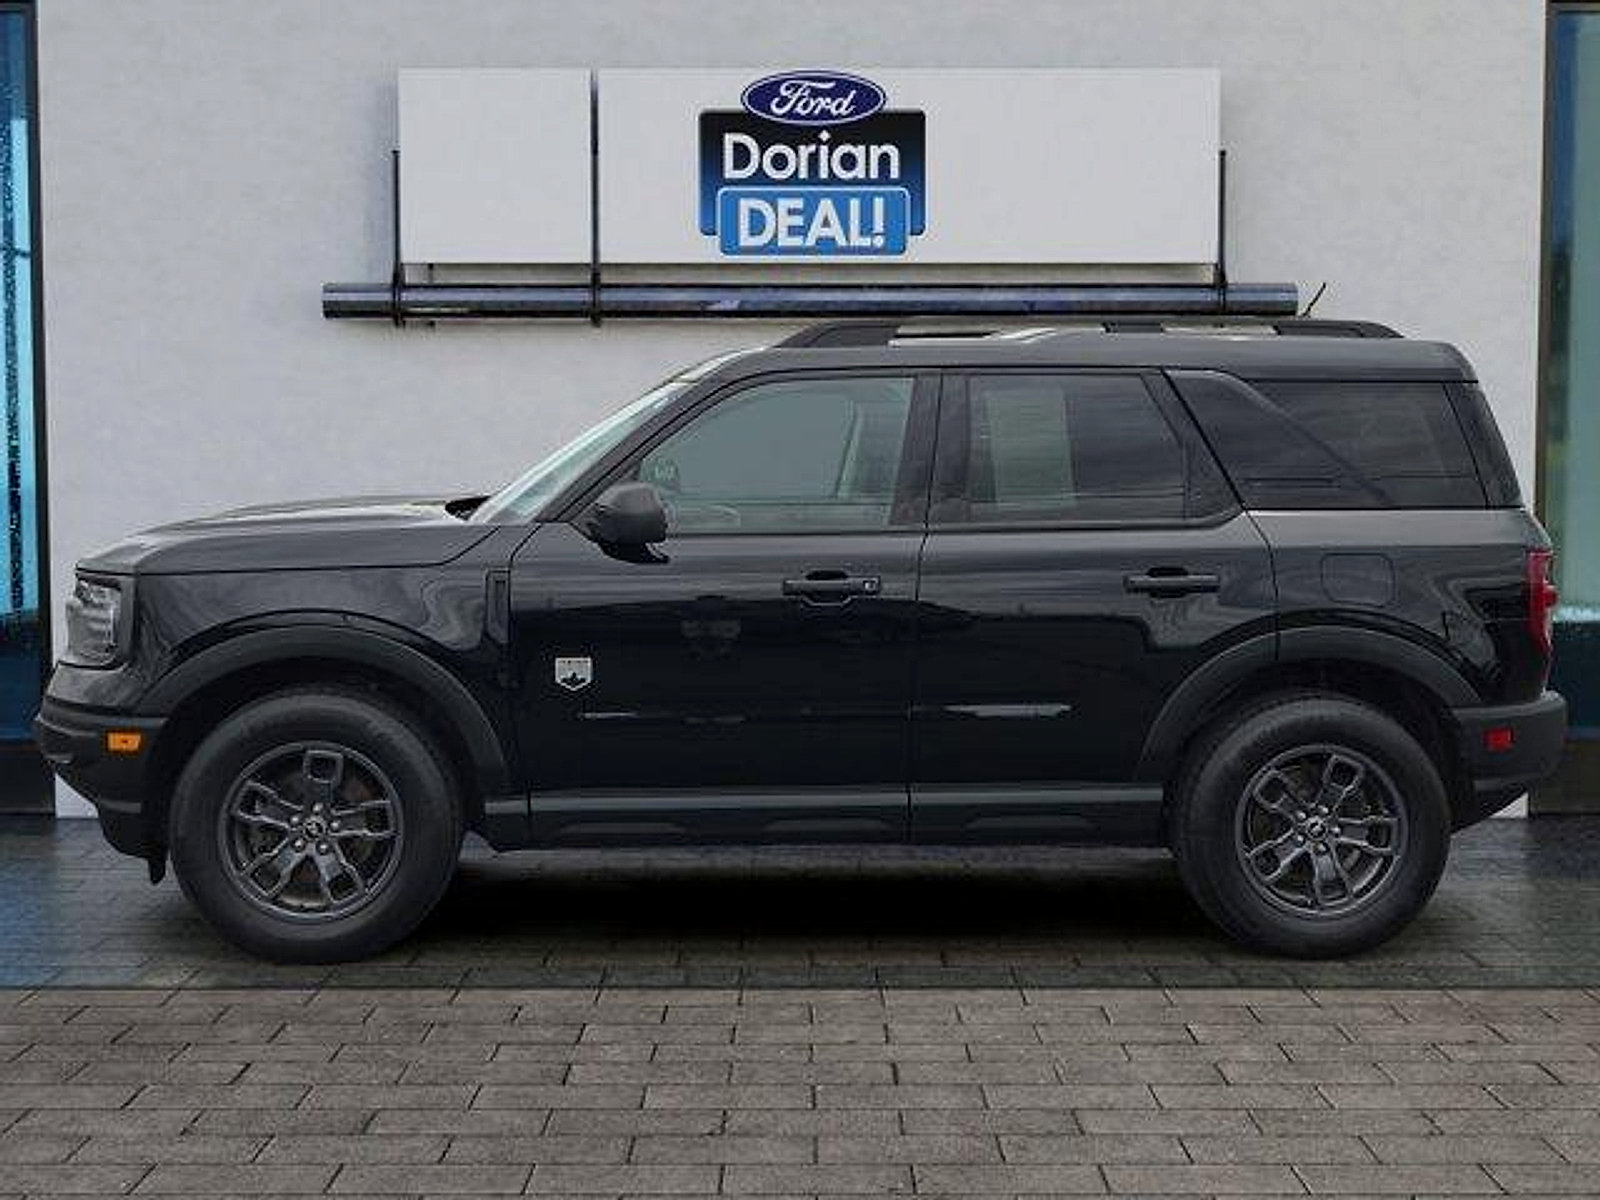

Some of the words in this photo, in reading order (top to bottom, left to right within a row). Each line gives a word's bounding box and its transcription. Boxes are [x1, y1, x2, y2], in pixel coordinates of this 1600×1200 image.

[770, 80, 857, 116] Ford
[722, 129, 900, 180] Dorian
[738, 197, 885, 248] DEAL!
